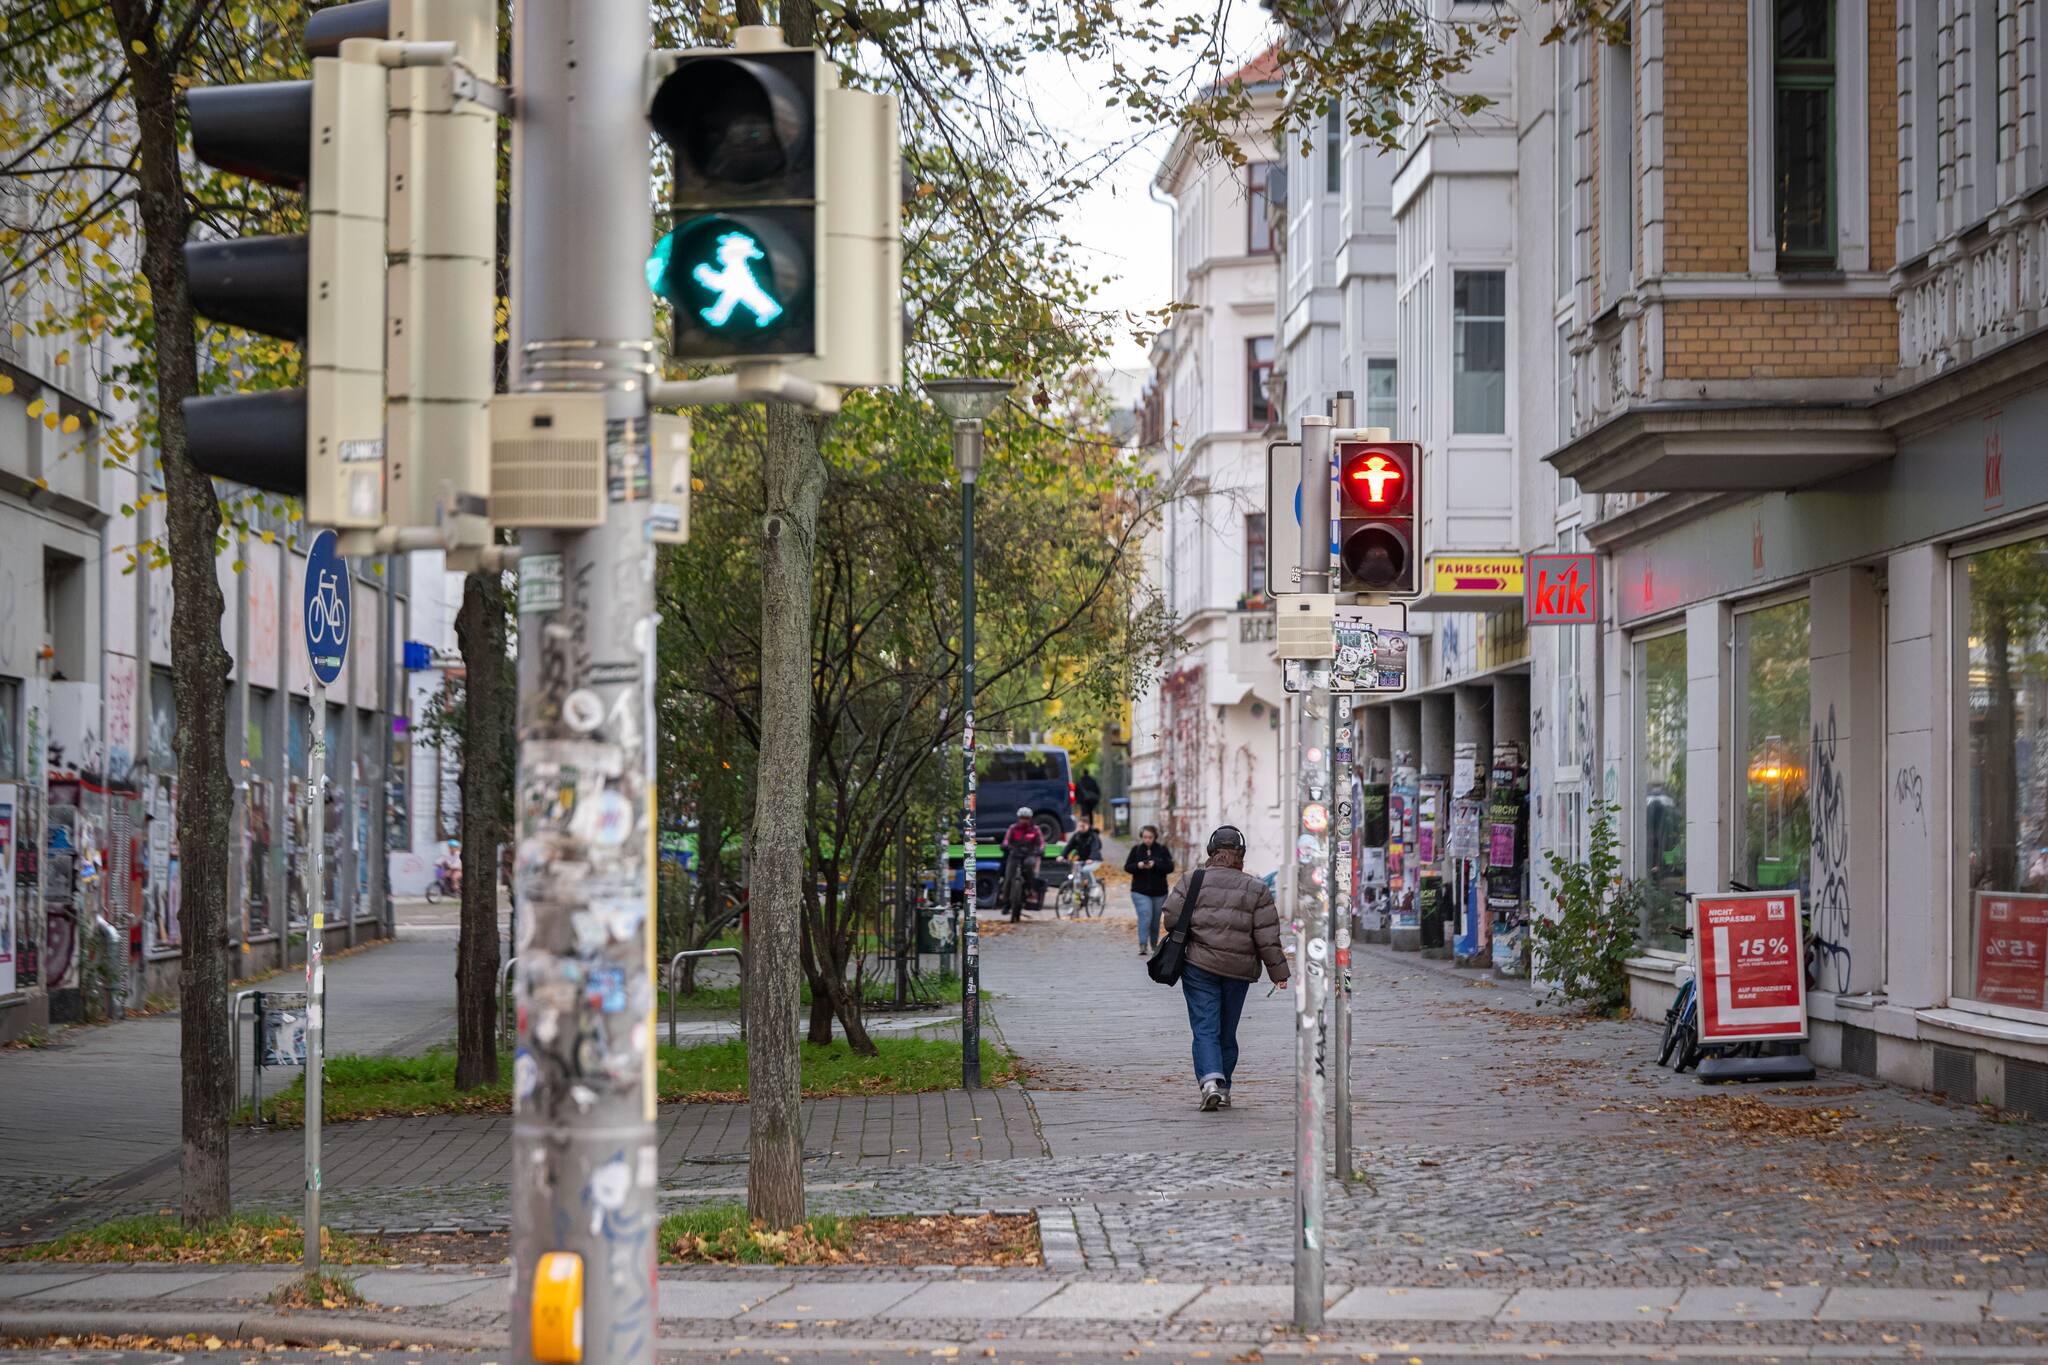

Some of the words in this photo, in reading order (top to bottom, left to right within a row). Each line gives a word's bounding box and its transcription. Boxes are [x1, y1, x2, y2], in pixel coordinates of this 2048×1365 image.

[1984, 434, 2002, 499] kik
[1535, 561, 1590, 615] kik
[1740, 939, 1765, 955] 15
[1769, 937, 1789, 955] %
